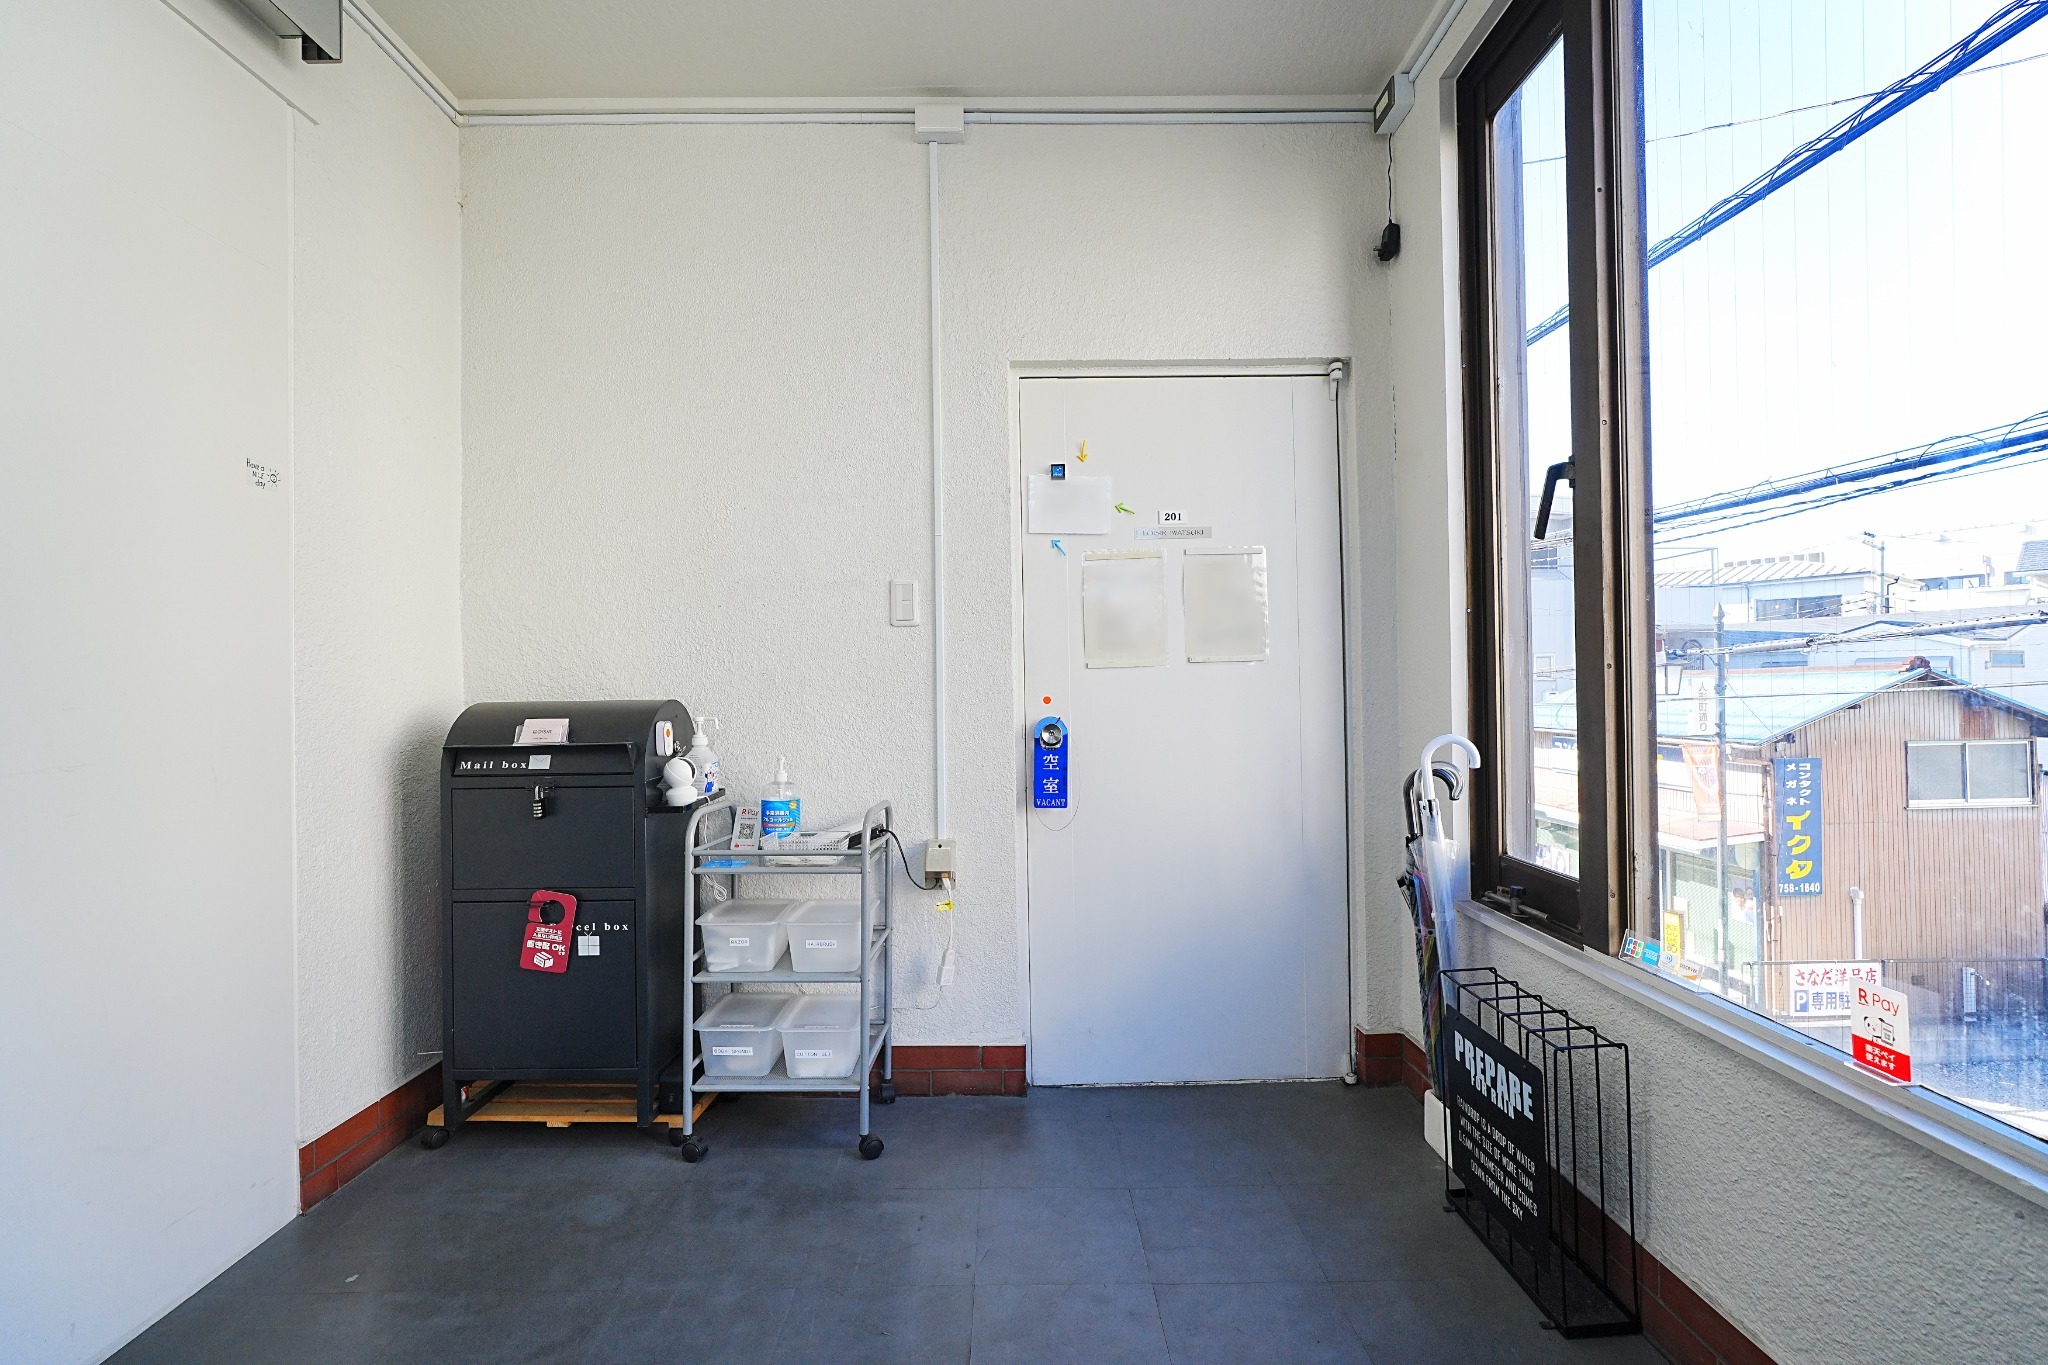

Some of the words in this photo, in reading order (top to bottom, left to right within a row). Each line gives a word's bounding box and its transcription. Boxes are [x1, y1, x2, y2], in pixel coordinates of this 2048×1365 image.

[255, 479, 265, 489] day
[1164, 512, 1182, 521] 201
[460, 761, 494, 770] Mail
[502, 761, 527, 769] box
[1042, 753, 1060, 794] 空室
[1785, 762, 1798, 806] メガネ
[1798, 763, 1812, 806] コンタクト
[1036, 798, 1066, 807] VACANT
[1785, 810, 1813, 880] イクタ
[575, 922, 597, 931] cel
[604, 922, 629, 931] box
[551, 943, 567, 953] OK
[1795, 967, 1877, 987] さなだ洋品店
[1811, 991, 1851, 1011] 専用駐
[1858, 987, 1869, 1006] R
[1872, 993, 1900, 1017] Pay
[1454, 1030, 1534, 1121] PREPARE
[1470, 1066, 1488, 1098] FOR
[1490, 1086, 1516, 1120] RAIN
[1460, 1114, 1472, 1135] WITH
[1472, 1125, 1481, 1144] THE
[1493, 1146, 1501, 1162] OF
[1501, 1153, 1517, 1179] MORE
[1518, 1169, 1534, 1194] THAN
[1492, 1126, 1507, 1148] DROP
[1507, 1140, 1515, 1156] OF
[1470, 1159, 1485, 1183] DOWN
[1485, 1174, 1500, 1199] FROM
[1501, 1189, 1512, 1210] THE
[1512, 1201, 1524, 1222] SKY
[1473, 1144, 1480, 1160] IN
[1505, 1176, 1517, 1197] AND
[1517, 1187, 1538, 1217] COMES
